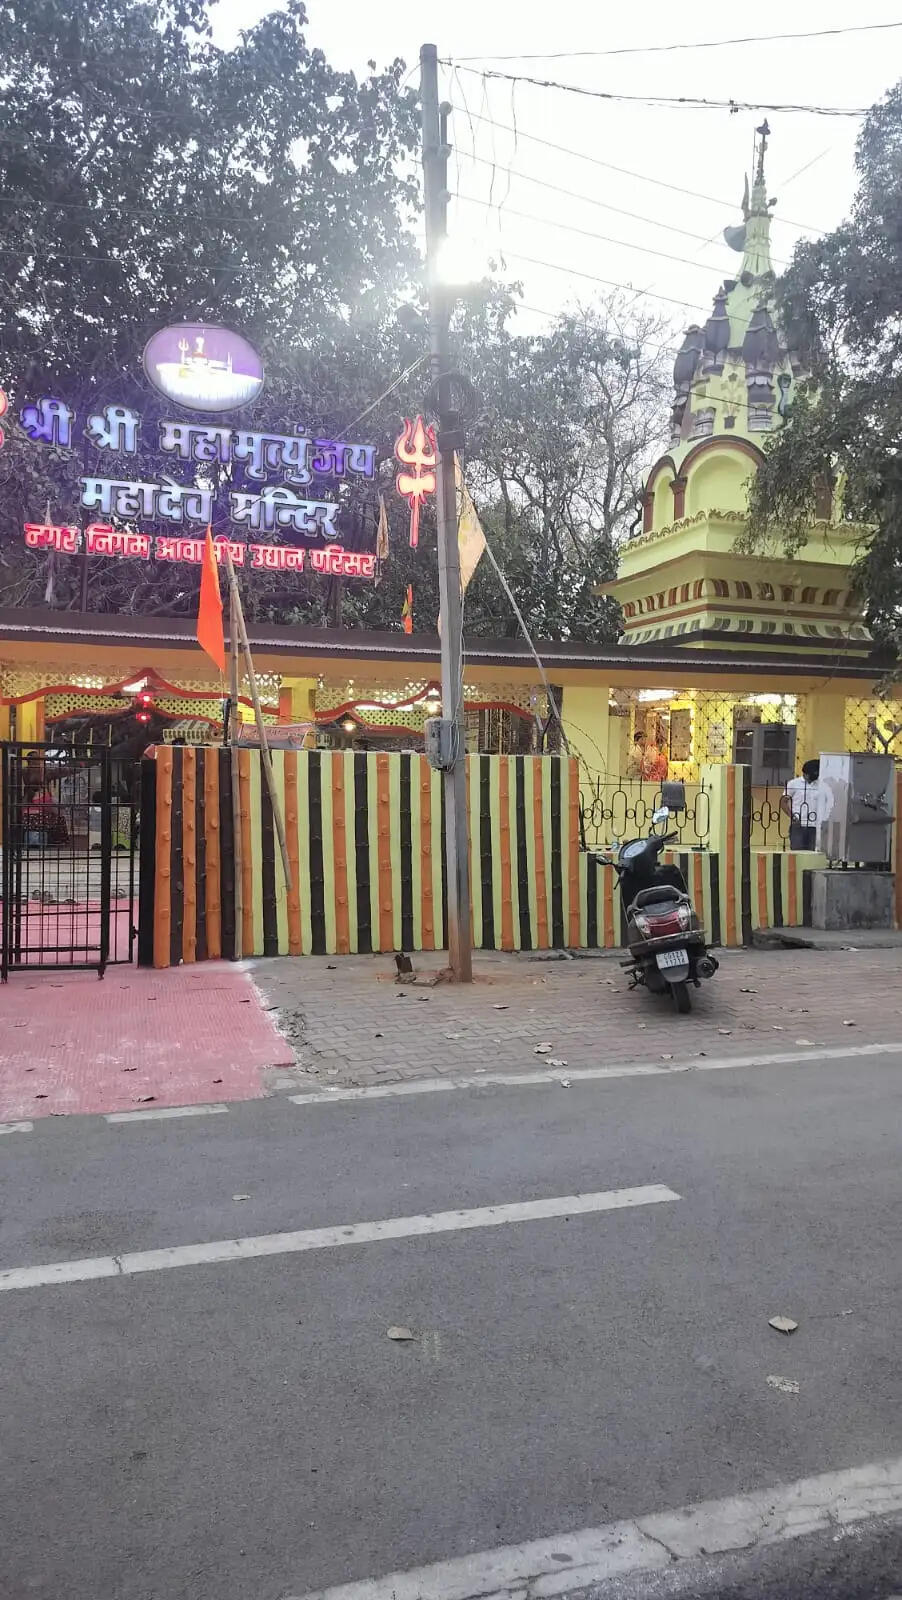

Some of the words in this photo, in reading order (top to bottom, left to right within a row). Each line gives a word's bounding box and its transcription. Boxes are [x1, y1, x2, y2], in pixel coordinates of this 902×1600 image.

[20, 397, 76, 449] श्री
[85, 405, 142, 455] श्री
[78, 473, 217, 525] महादेव
[230, 487, 341, 538] मन्दिर
[24, 522, 79, 554] नगर
[85, 522, 152, 559] निगम
[250, 543, 305, 572] उद्यान
[309, 543, 377, 578] परिसर
